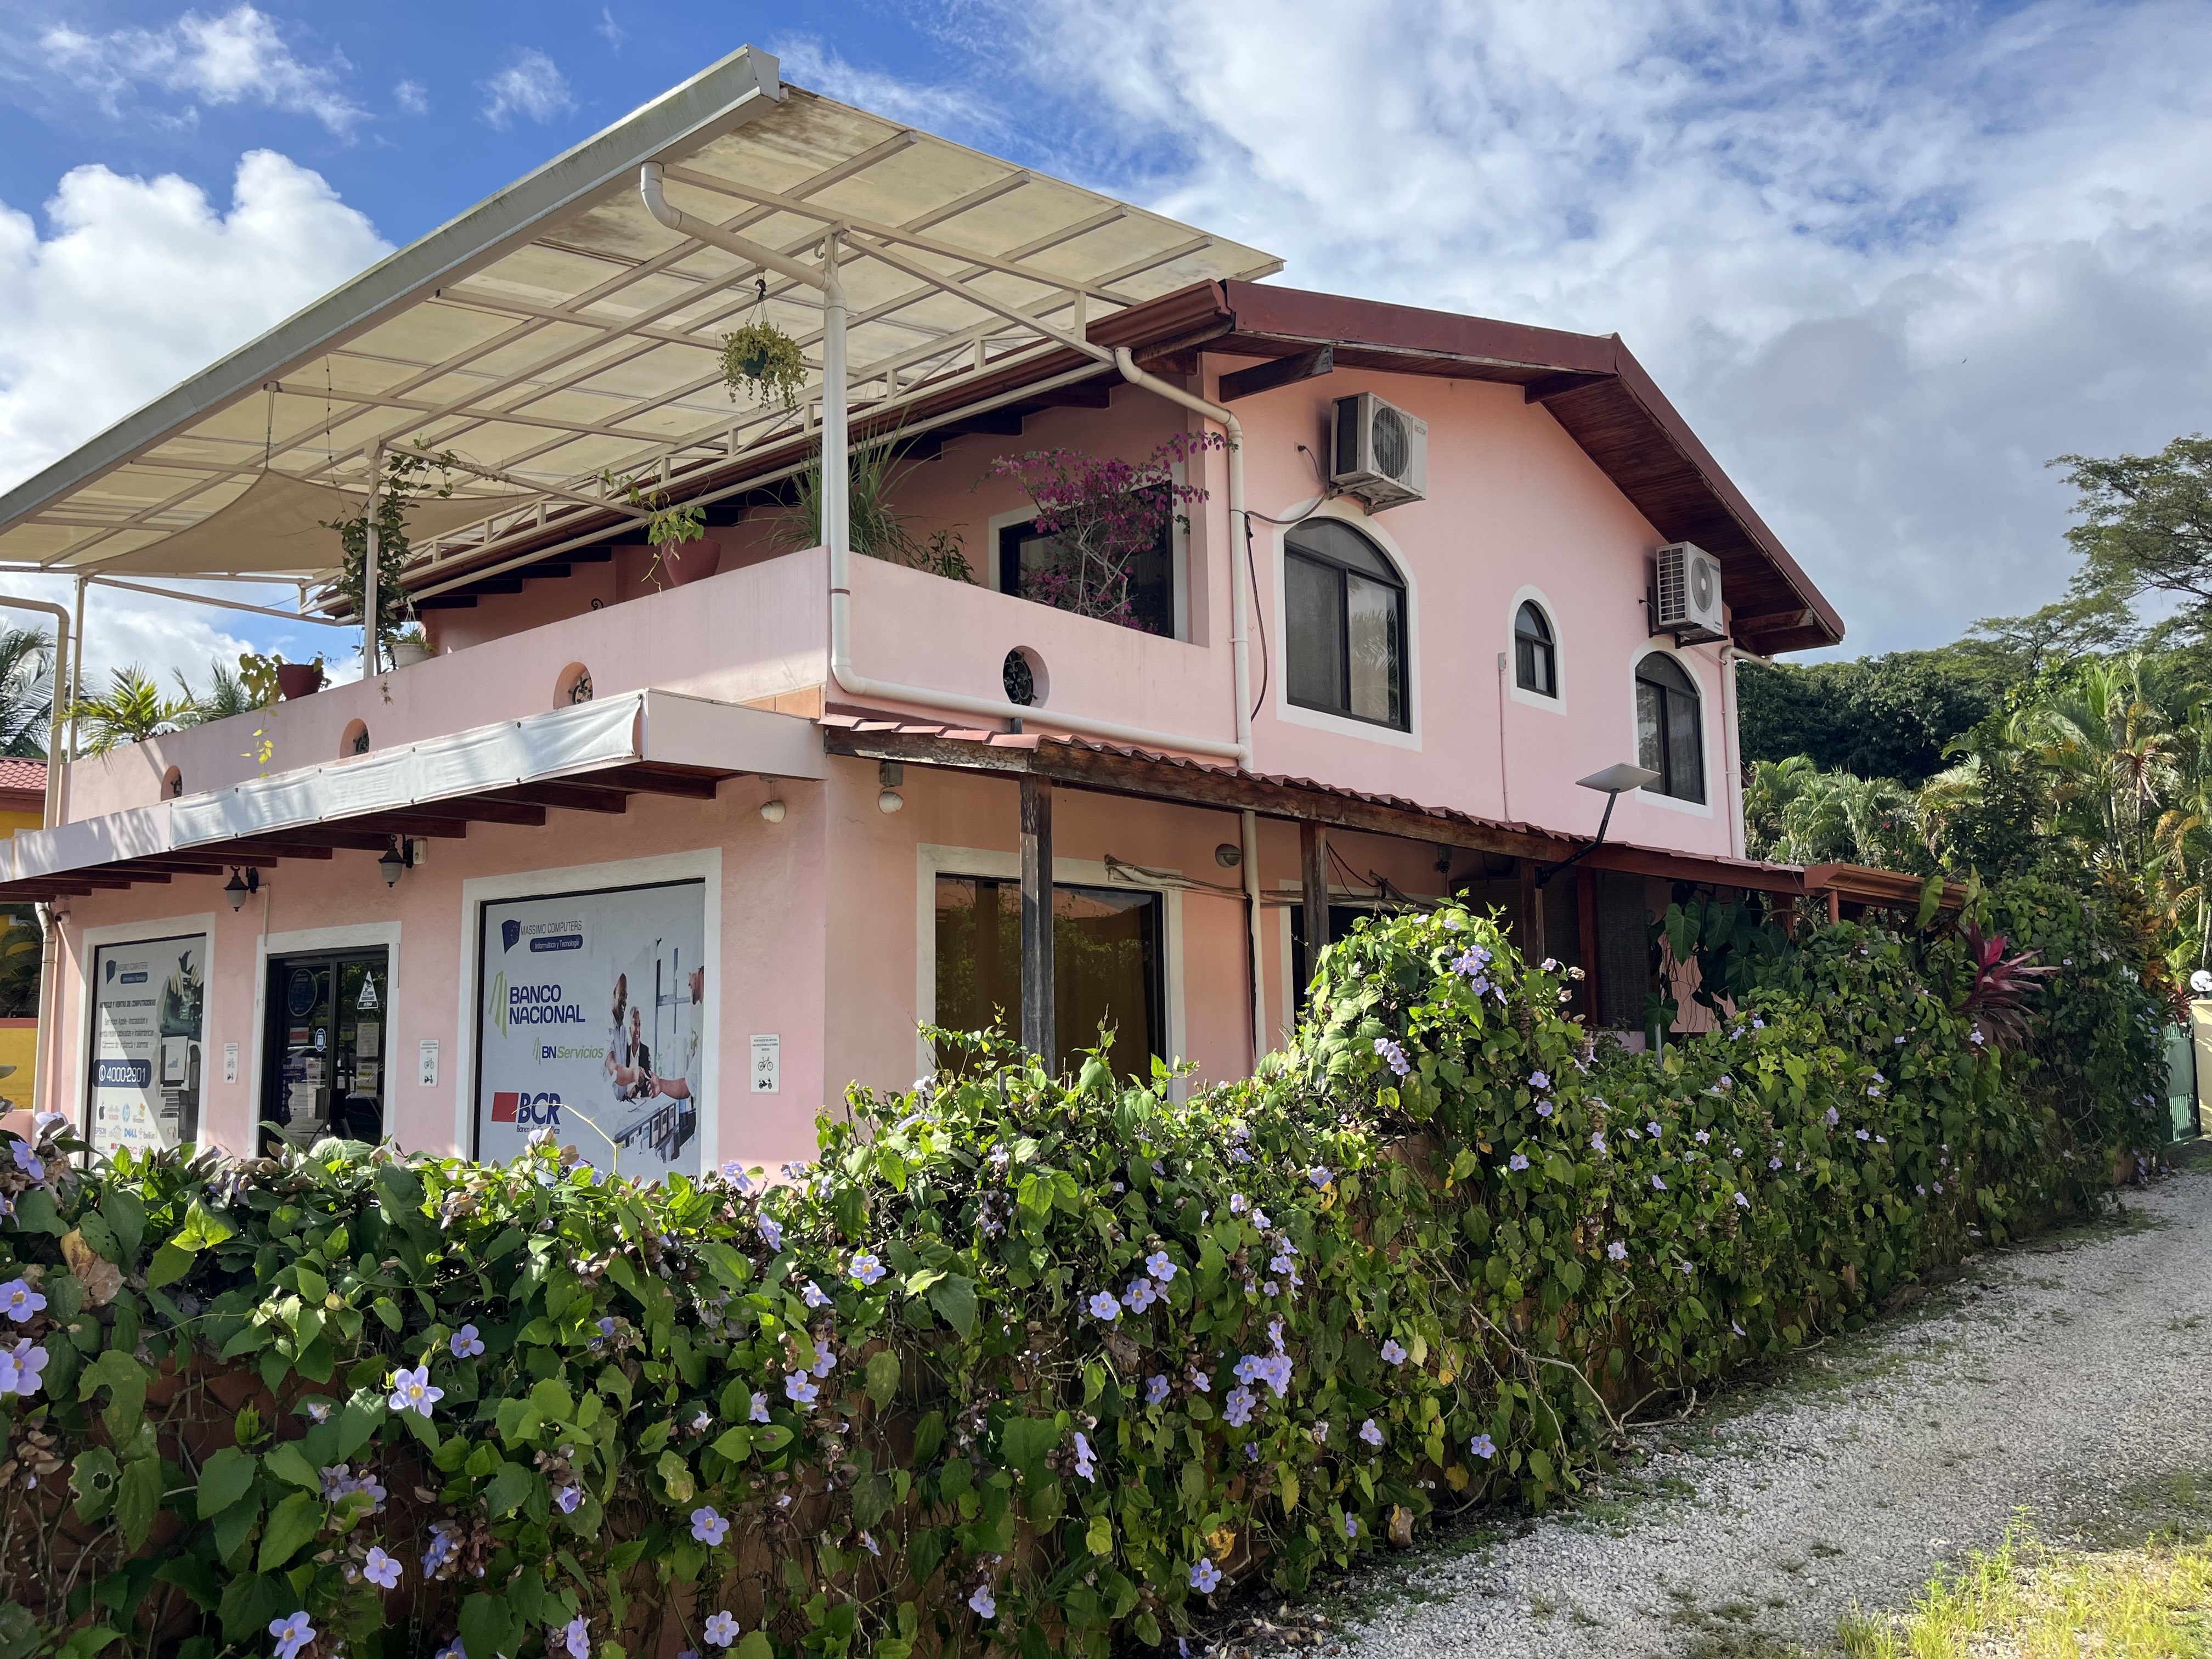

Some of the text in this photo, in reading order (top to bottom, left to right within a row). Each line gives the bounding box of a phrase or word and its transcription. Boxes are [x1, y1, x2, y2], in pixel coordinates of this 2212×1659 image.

[521, 921, 582, 935] MASSIMO COMPUTERS
[510, 985, 562, 1005] BANCO
[509, 1005, 585, 1024] NACIONAL
[106, 1067, 146, 1082] 4000-2901
[518, 1092, 560, 1125] BCR
[516, 1124, 530, 1133] Banco
